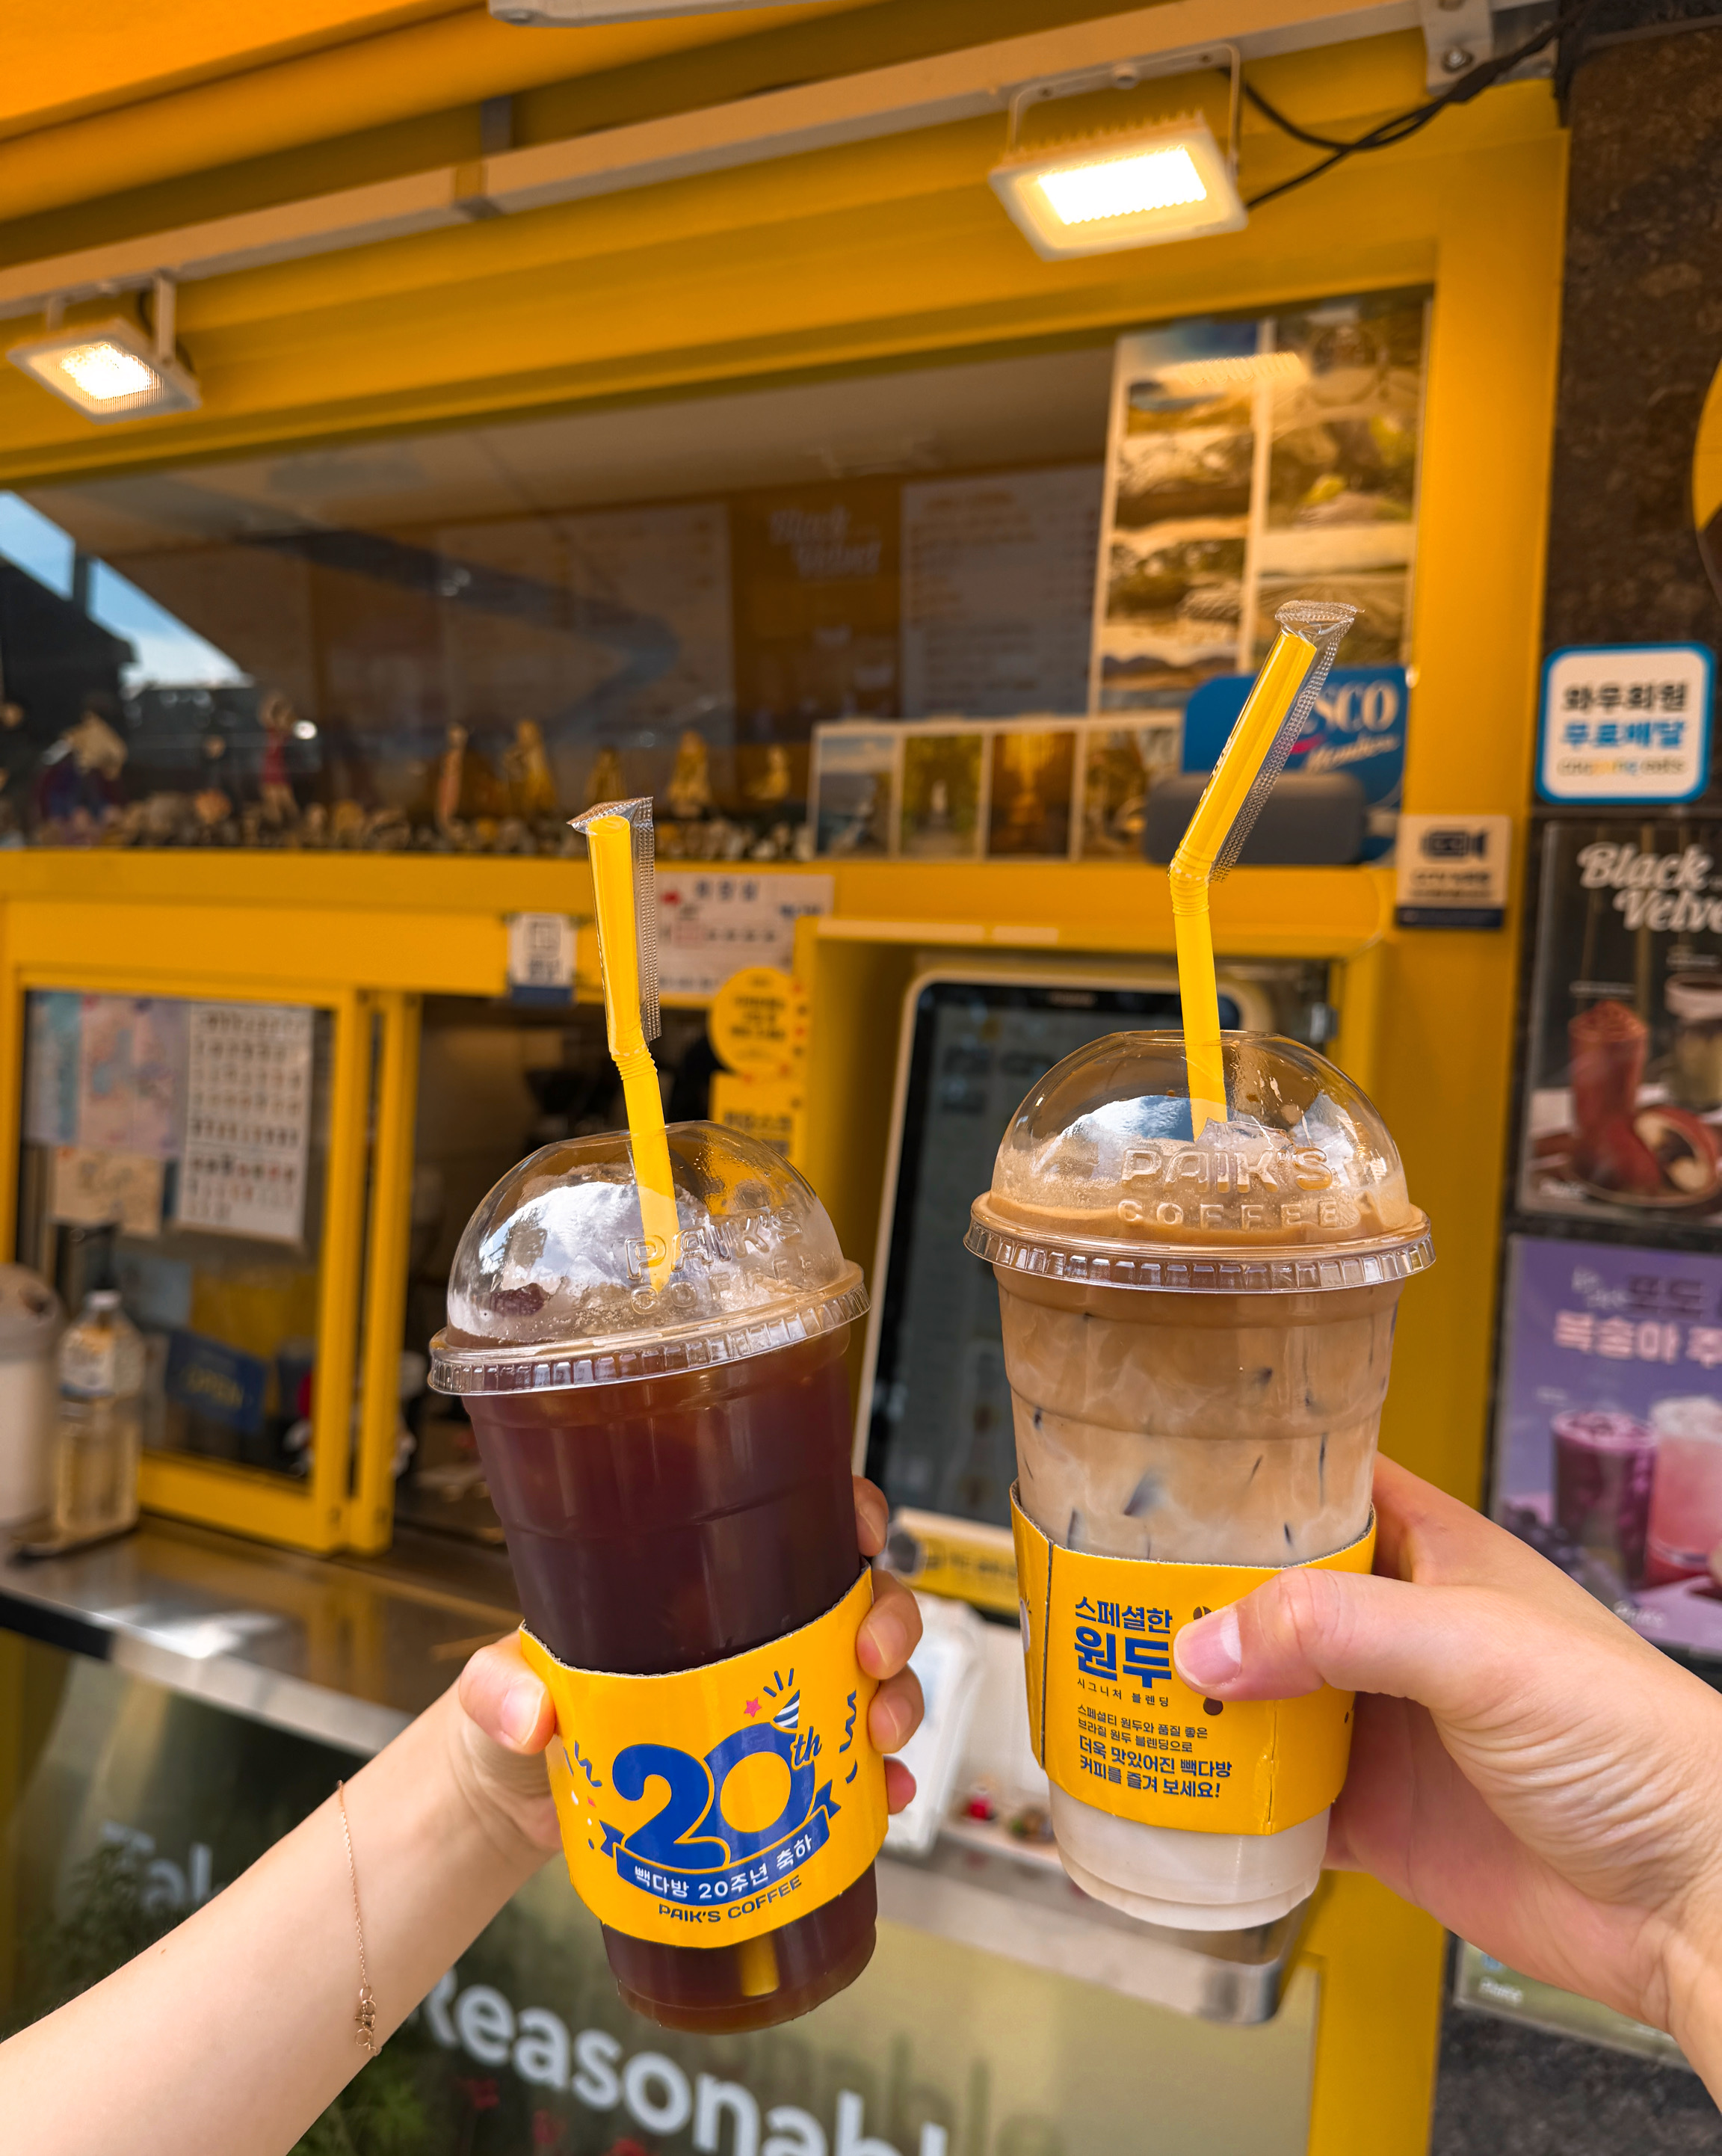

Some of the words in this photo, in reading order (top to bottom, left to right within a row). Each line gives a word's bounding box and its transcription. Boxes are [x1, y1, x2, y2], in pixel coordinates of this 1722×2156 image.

[1577, 841, 1713, 890] Black
[1120, 1147, 1333, 1194] PAIK'S
[1117, 1198, 1339, 1231] COFFEE
[1075, 1595, 1173, 1634] 스페셜한
[1074, 1625, 1172, 1689] 원두
[1077, 1677, 1122, 1700] 시그니처
[1132, 1692, 1169, 1707] 블렌딩
[1077, 1703, 1117, 1726] 스페셜티
[1120, 1717, 1154, 1734] 원두와
[1158, 1723, 1180, 1737] 품질
[1185, 1725, 1208, 1740] 좋은
[1078, 1716, 1107, 1737] 브라질
[1111, 1728, 1132, 1744] 원두
[1135, 1734, 1193, 1753] 블렌딩으로
[1079, 1734, 1107, 1760] 더욱
[1111, 1746, 1175, 1775] 맛있어진
[1180, 1758, 1232, 1778] 빽다방
[1079, 1754, 1122, 1785] 커피를
[1126, 1770, 1158, 1793] 즐겨
[1162, 1778, 1220, 1799] 보세요!
[634, 1865, 690, 1898] 빽다방
[698, 1862, 769, 1900] 20주년
[776, 1834, 812, 1870] 축하
[658, 1903, 721, 1924] PAIK'S
[727, 1874, 803, 1920] COFFEE
